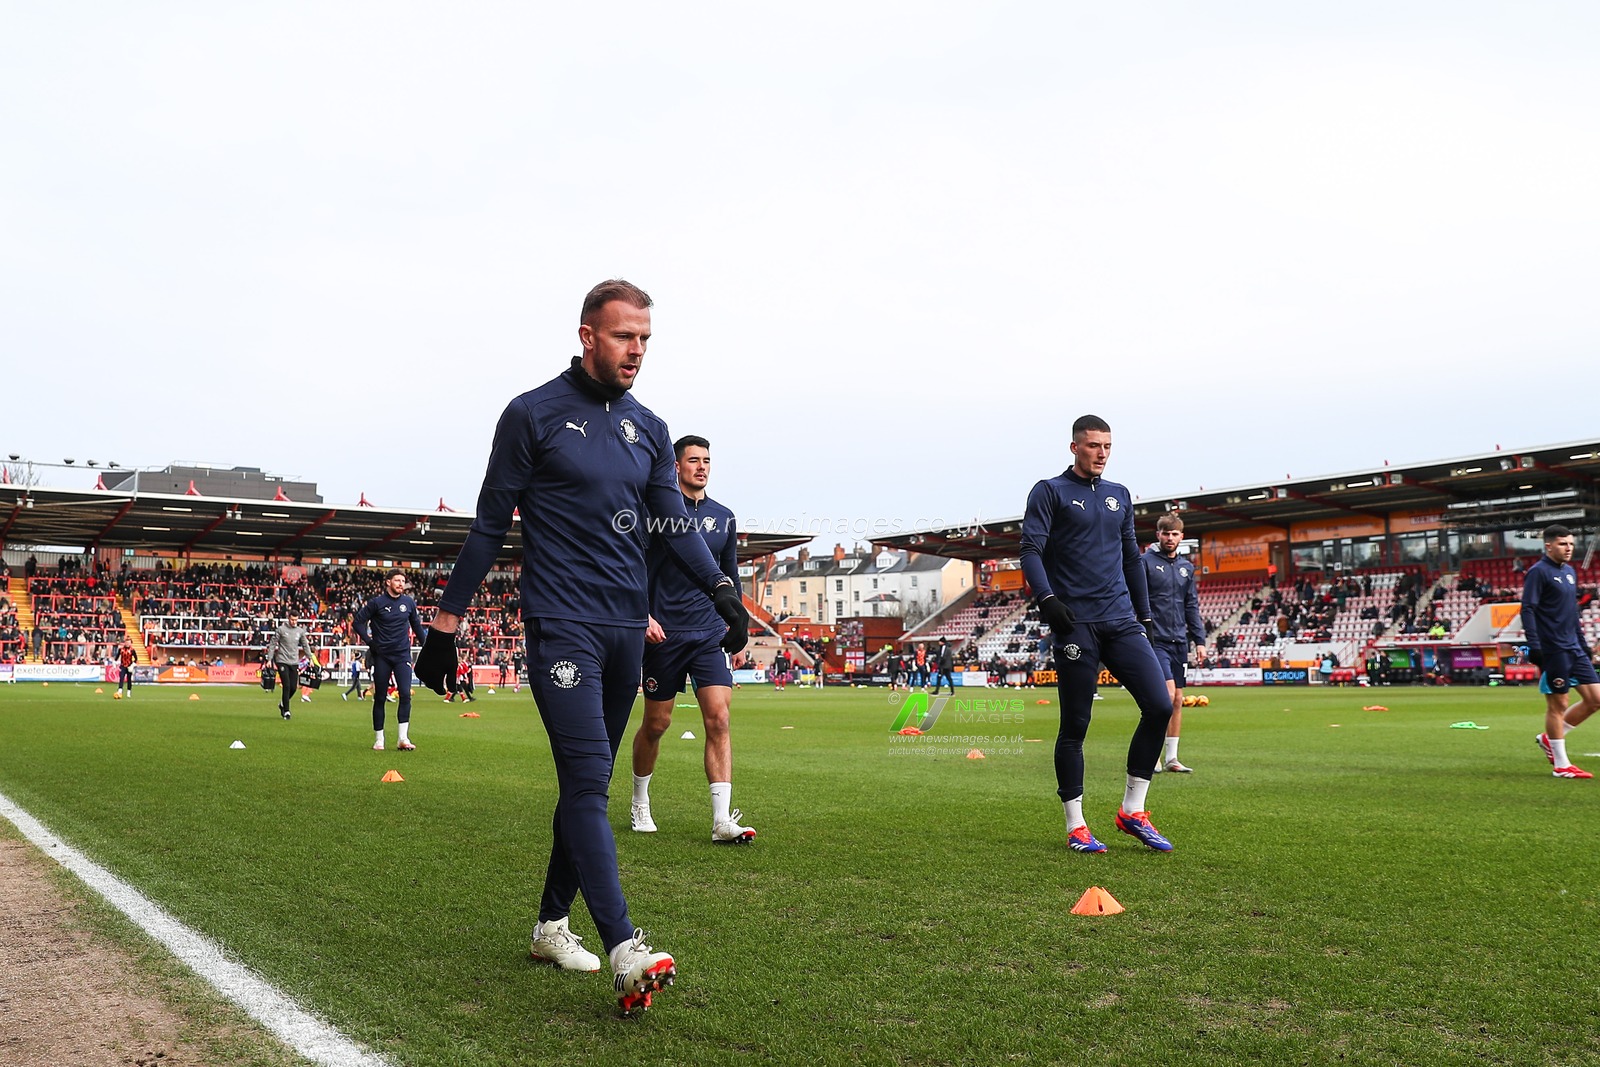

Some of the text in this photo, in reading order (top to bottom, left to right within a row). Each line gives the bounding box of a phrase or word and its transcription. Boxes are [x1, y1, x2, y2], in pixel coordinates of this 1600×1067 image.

[16, 665, 80, 676] exeter college
[550, 660, 579, 674] BLACKPOOL
